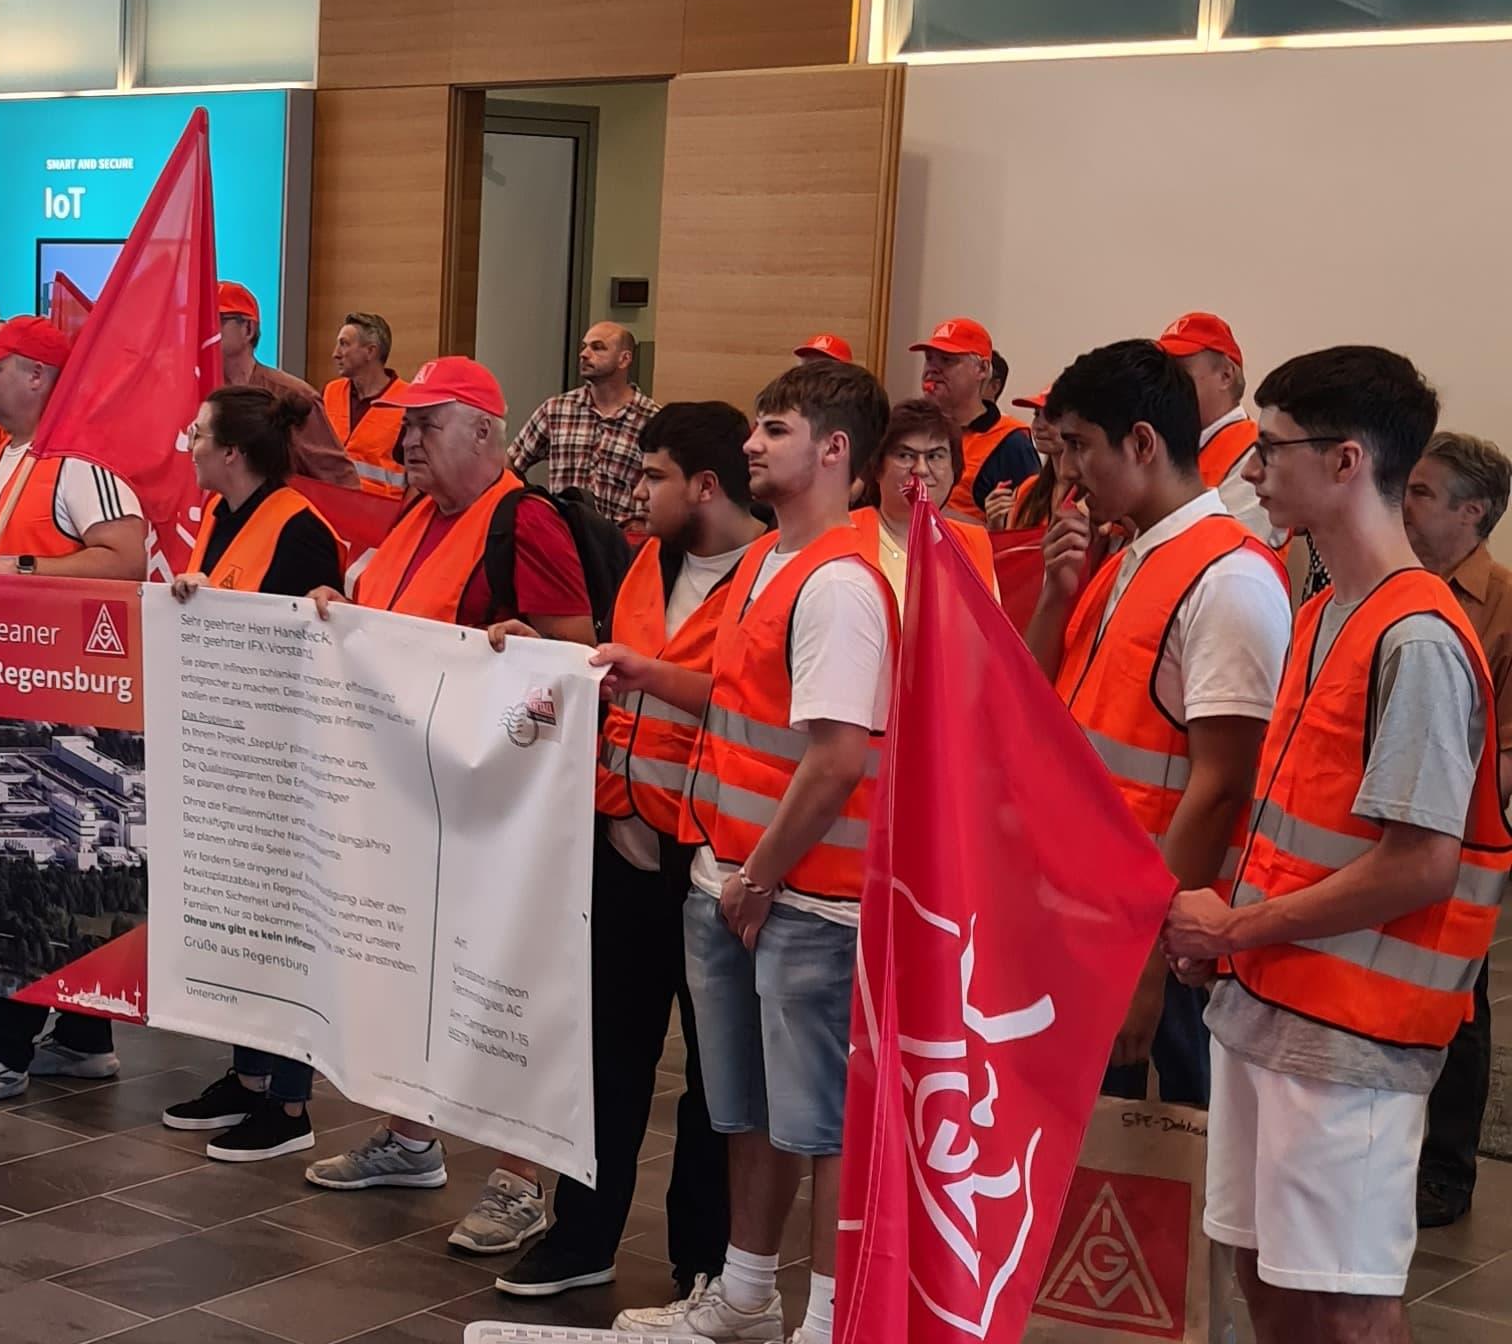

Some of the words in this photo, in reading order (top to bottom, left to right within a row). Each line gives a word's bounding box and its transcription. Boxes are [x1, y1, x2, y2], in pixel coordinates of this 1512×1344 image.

[46, 158, 76, 170] SMART
[77, 158, 97, 169] AND
[98, 157, 134, 169] SECURE
[45, 186, 86, 219] IoT
[181, 614, 201, 626] Sehr
[204, 618, 245, 632] geehrter
[248, 622, 271, 635] Herr
[181, 633, 201, 643] sehr
[203, 636, 245, 649] geehrter
[183, 914, 207, 927] Ohne
[209, 920, 226, 931] uns
[228, 924, 247, 936] gibt
[248, 929, 259, 938] es
[261, 929, 283, 942] kein
[184, 935, 218, 953] Grüße
[220, 945, 240, 957] aus
[242, 947, 309, 976] Regensburg
[186, 985, 238, 1004] Unterschrift
[506, 1003, 523, 1018] AG
